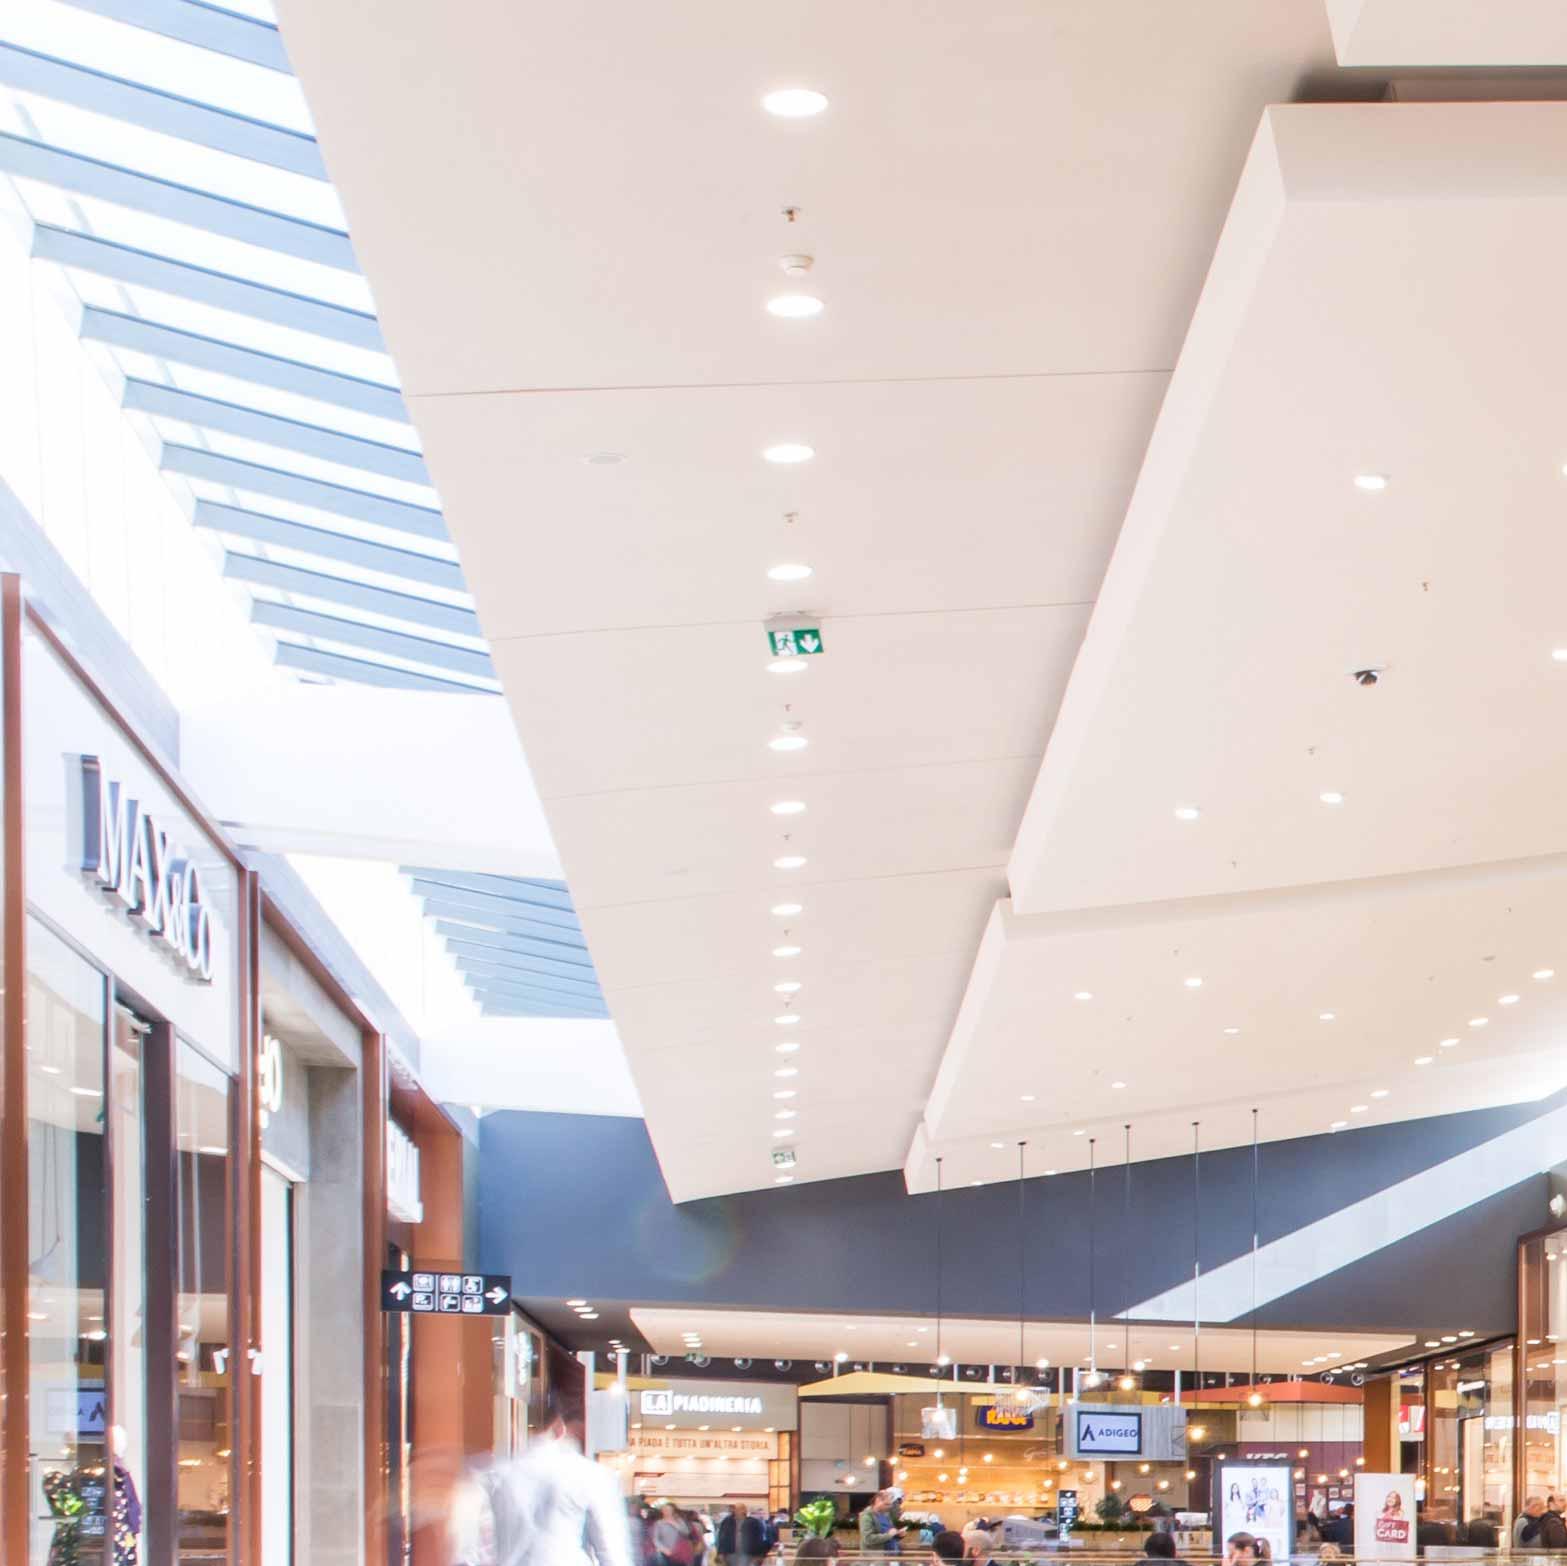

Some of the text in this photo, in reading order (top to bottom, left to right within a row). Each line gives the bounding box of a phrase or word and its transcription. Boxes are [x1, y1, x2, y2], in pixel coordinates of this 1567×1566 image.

[646, 1393, 763, 1414] LA PIADINERIA
[1098, 1428, 1138, 1438] ADIGEO
[639, 1437, 662, 1448] PIADA
[673, 1439, 697, 1449] TUTTA
[1376, 1528, 1406, 1539] CARD
